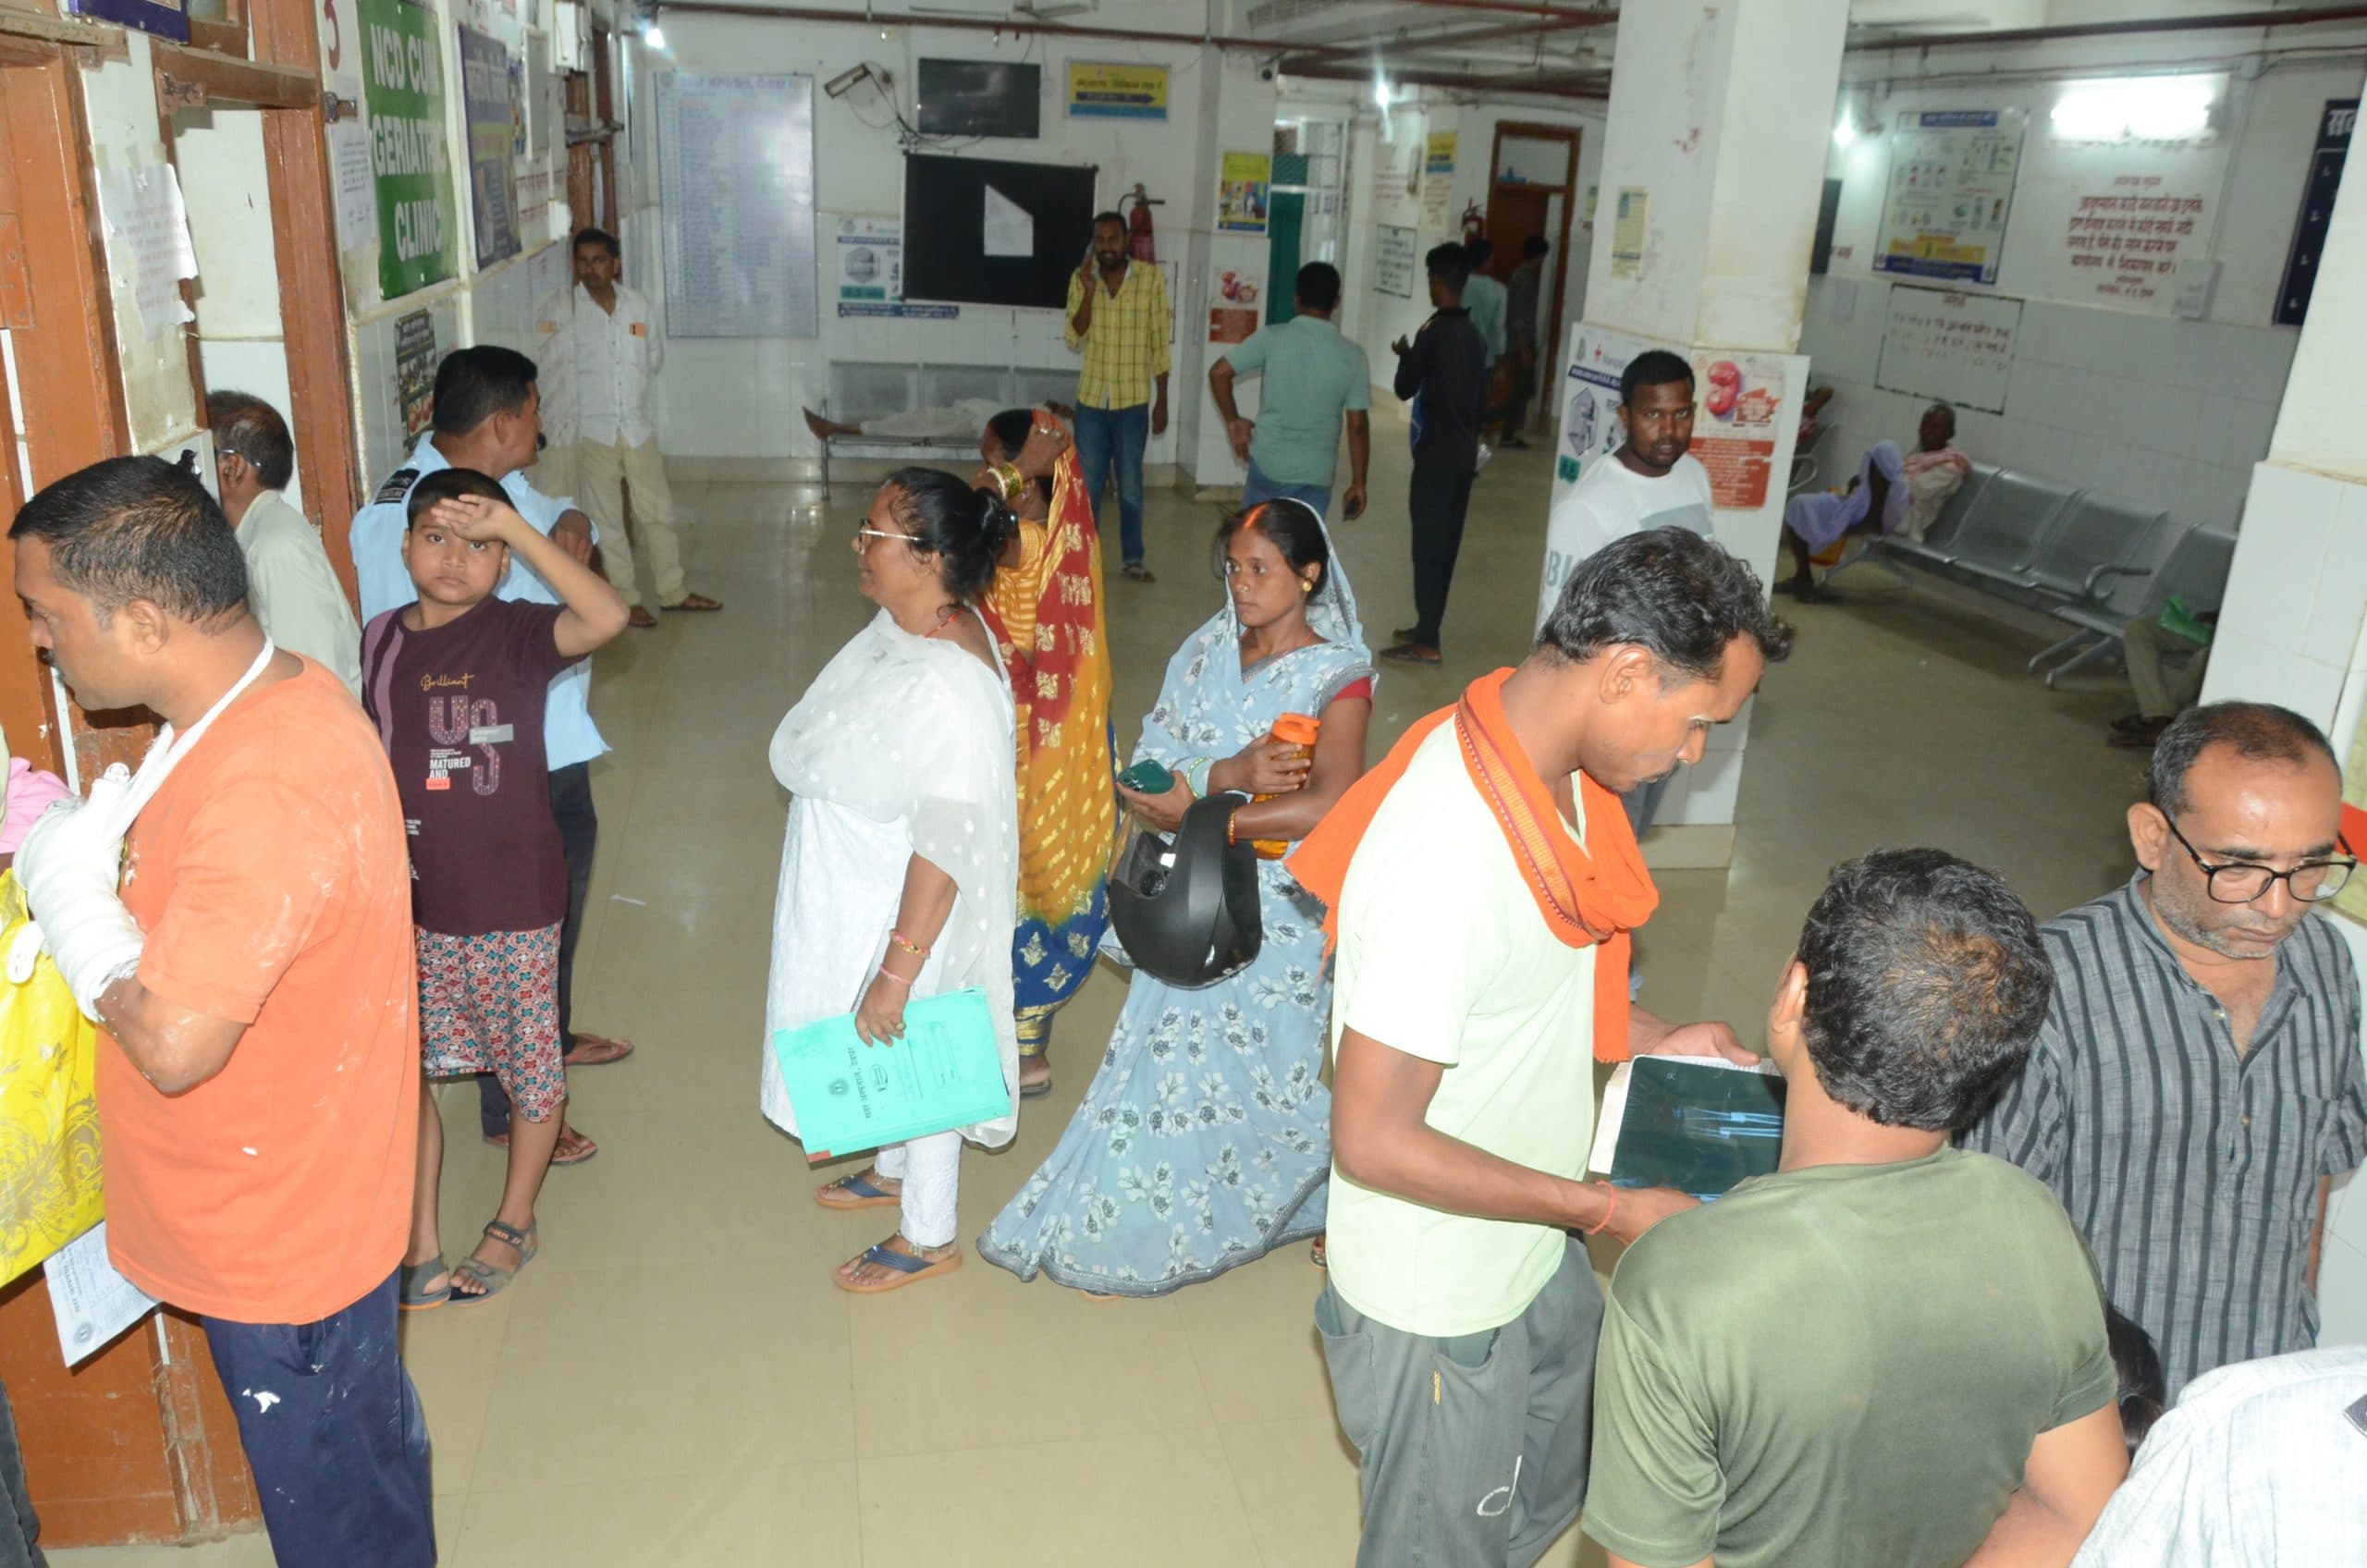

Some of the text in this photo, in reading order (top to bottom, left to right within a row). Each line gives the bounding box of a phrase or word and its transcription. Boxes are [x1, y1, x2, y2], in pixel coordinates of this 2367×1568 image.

[370, 23, 405, 90] NCD
[408, 35, 440, 95] CUM
[372, 114, 448, 177] GERIATRIC
[395, 198, 443, 261] CLINIC
[421, 672, 475, 692] Brilliant
[429, 756, 472, 770] MATURED
[429, 769, 448, 779] AND
